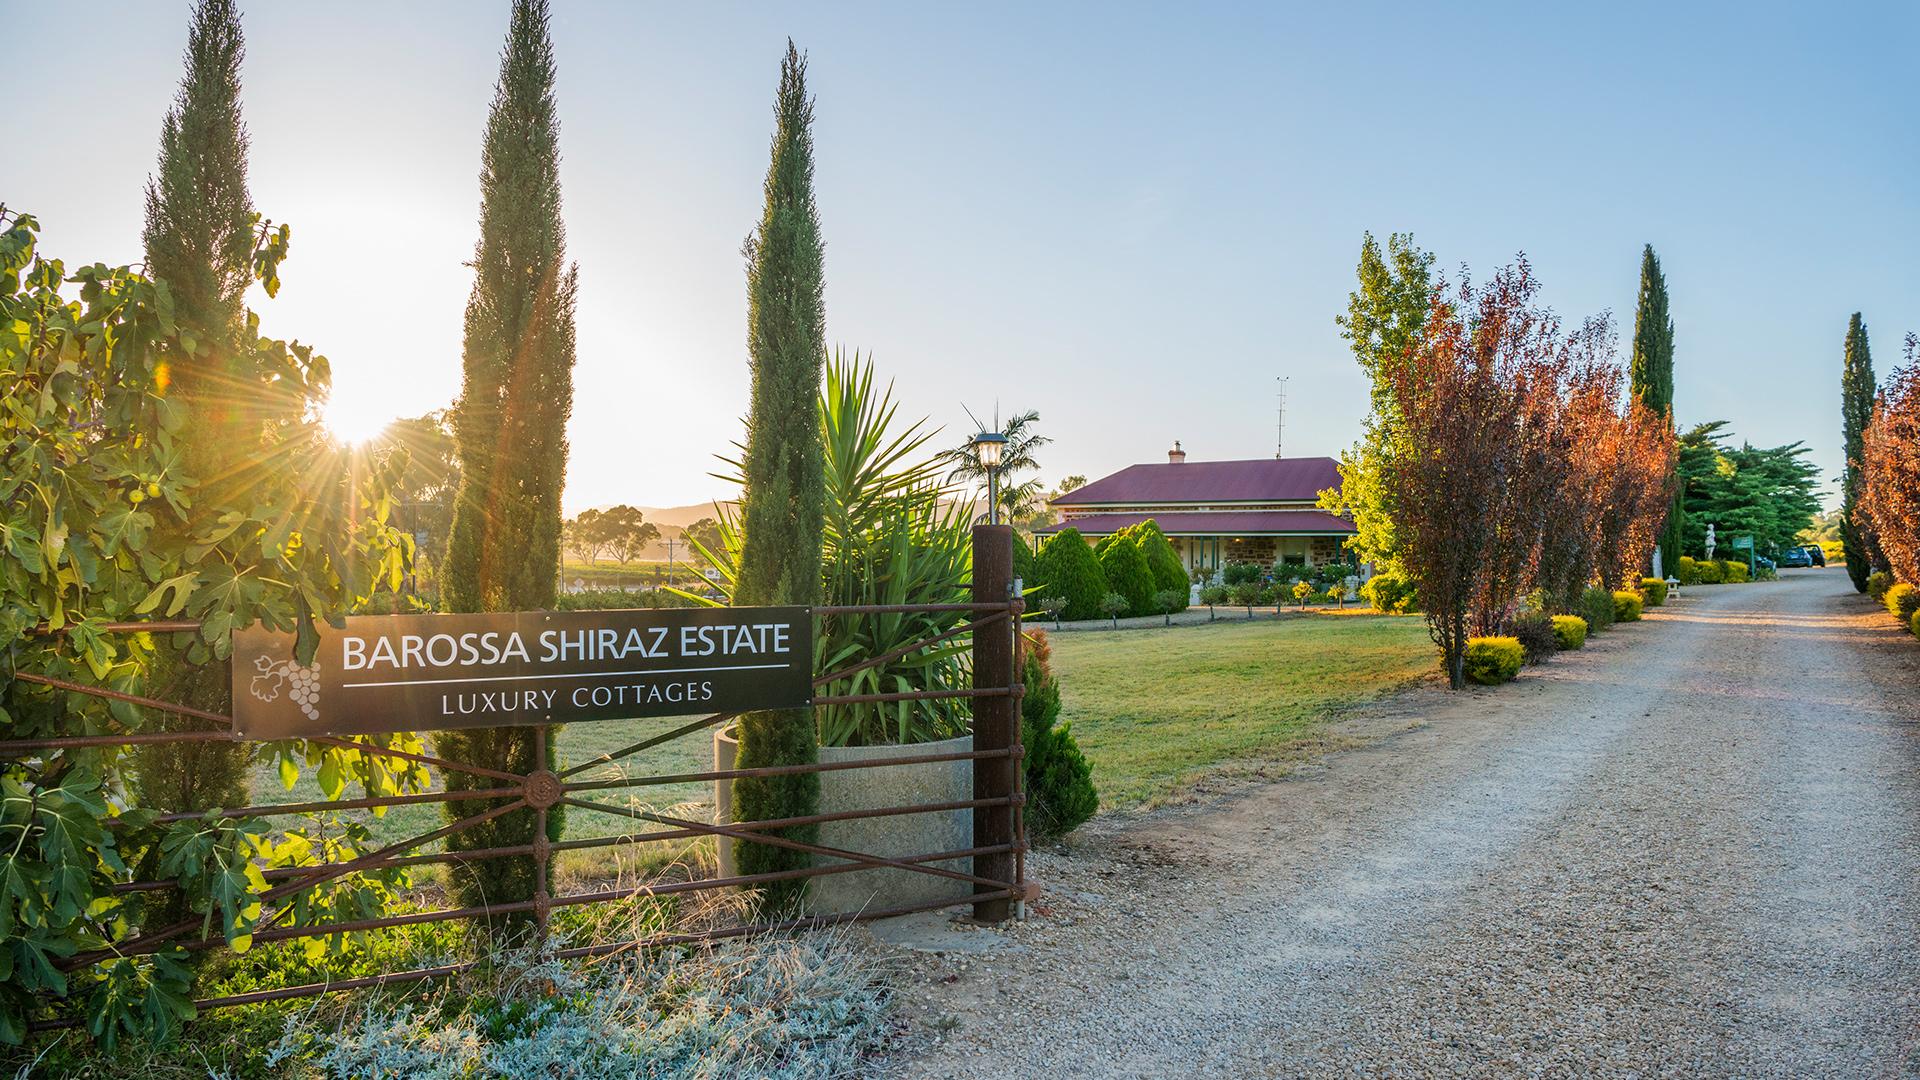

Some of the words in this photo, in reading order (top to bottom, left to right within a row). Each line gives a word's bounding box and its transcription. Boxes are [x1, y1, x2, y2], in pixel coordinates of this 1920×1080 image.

[343, 632, 530, 670] BAROSSA
[540, 627, 669, 662] SHIRAZ
[680, 624, 790, 656] ESTATE
[442, 689, 557, 715] LUXURY
[572, 681, 713, 708] COTTAGES
